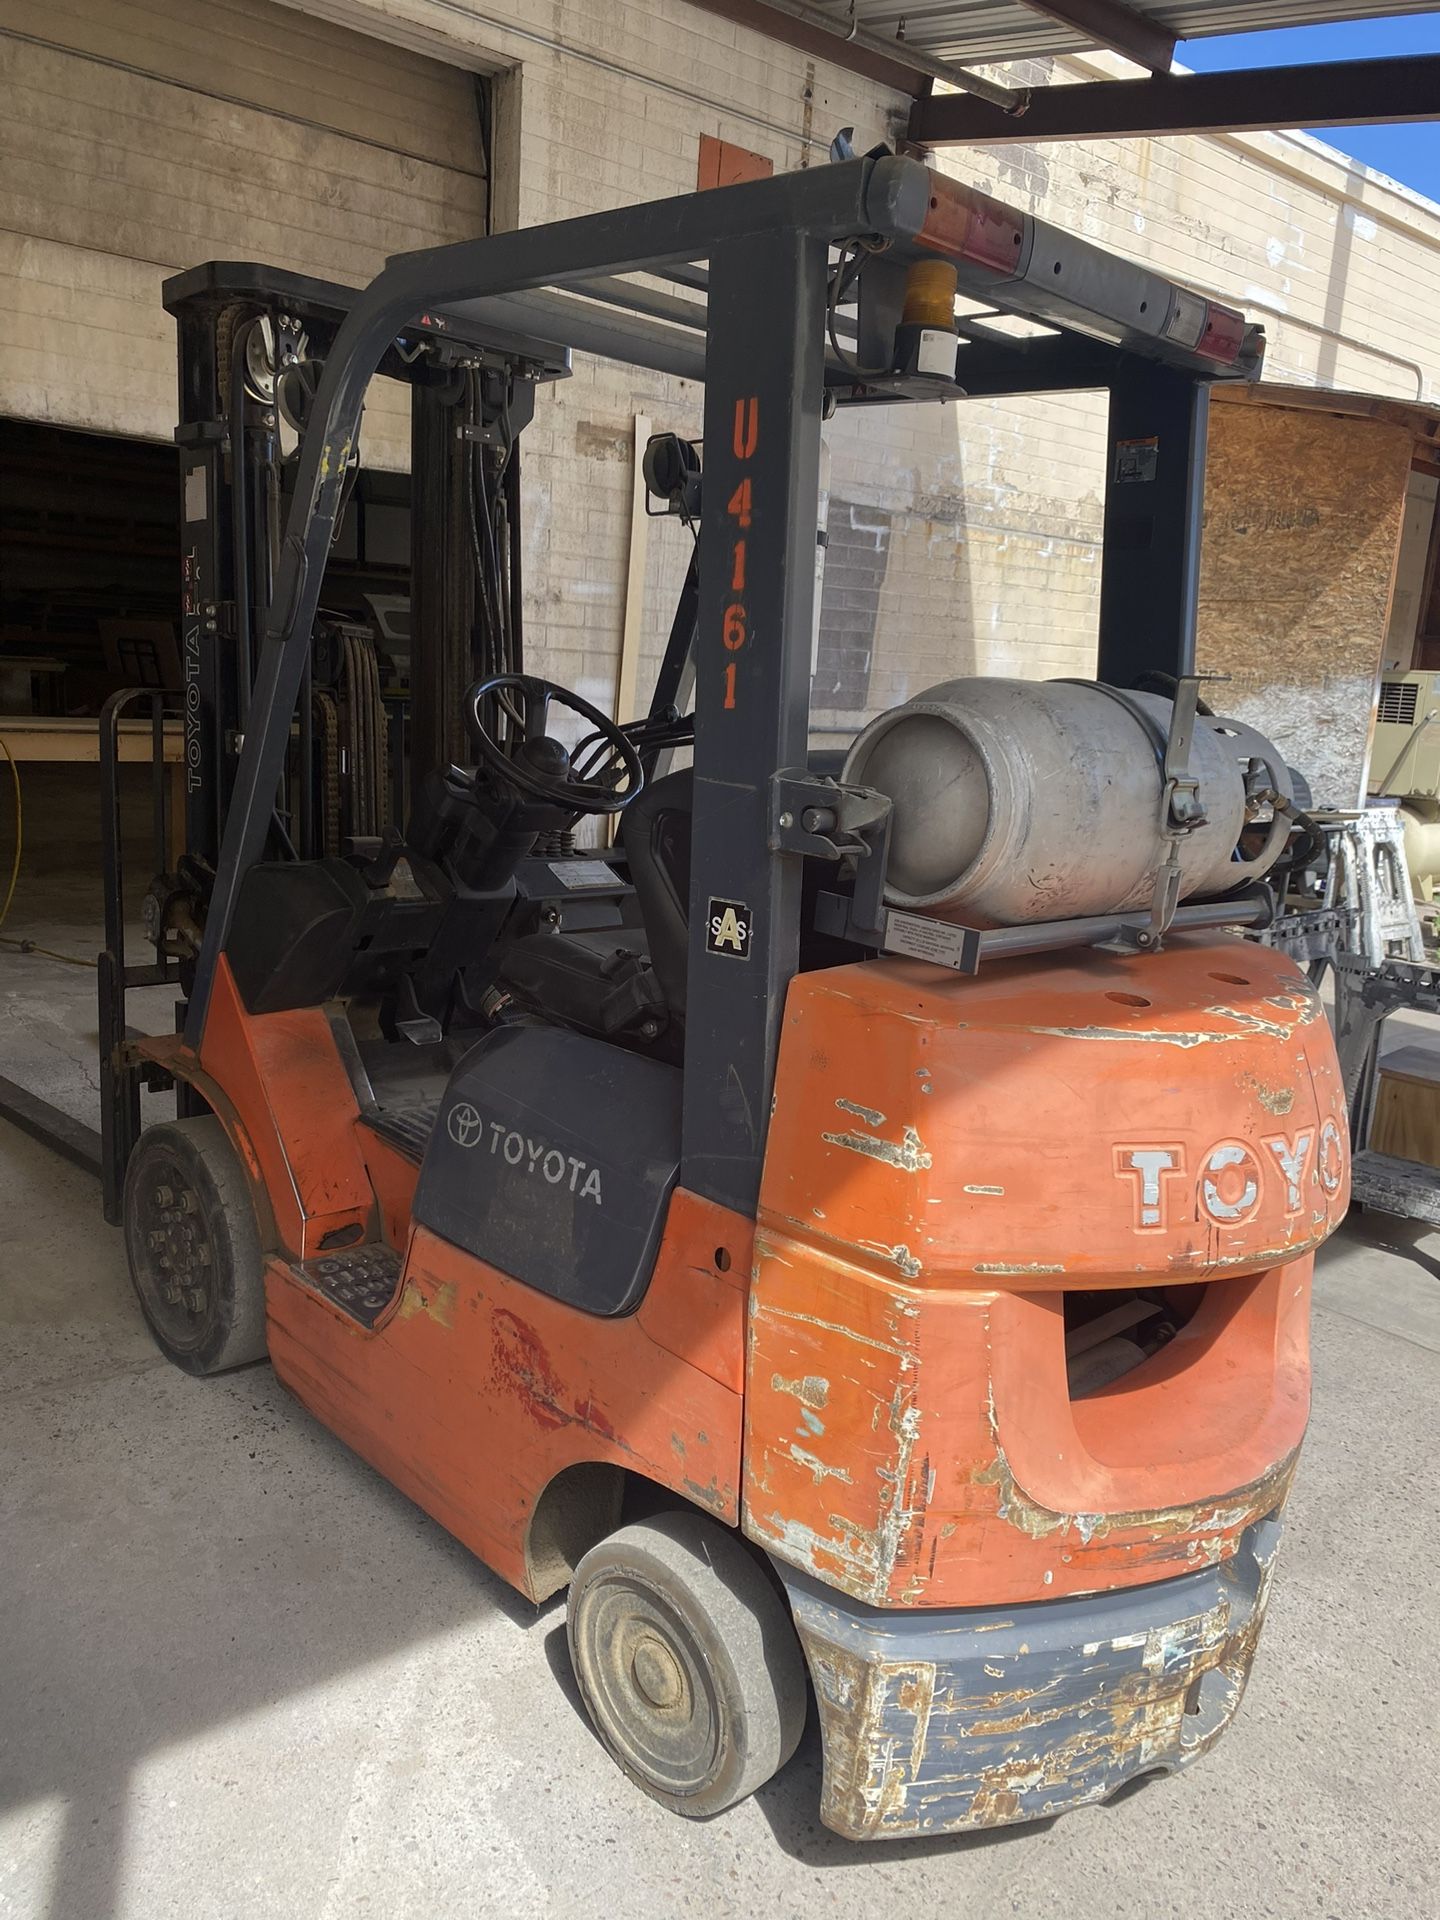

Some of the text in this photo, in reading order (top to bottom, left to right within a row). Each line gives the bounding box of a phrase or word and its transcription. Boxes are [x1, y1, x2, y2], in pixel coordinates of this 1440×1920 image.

[185, 624, 202, 794] TOYOTA
[711, 907, 747, 951] SAS
[490, 1121, 602, 1205] TOYOTA
[1112, 1115, 1344, 1236] TOYO
